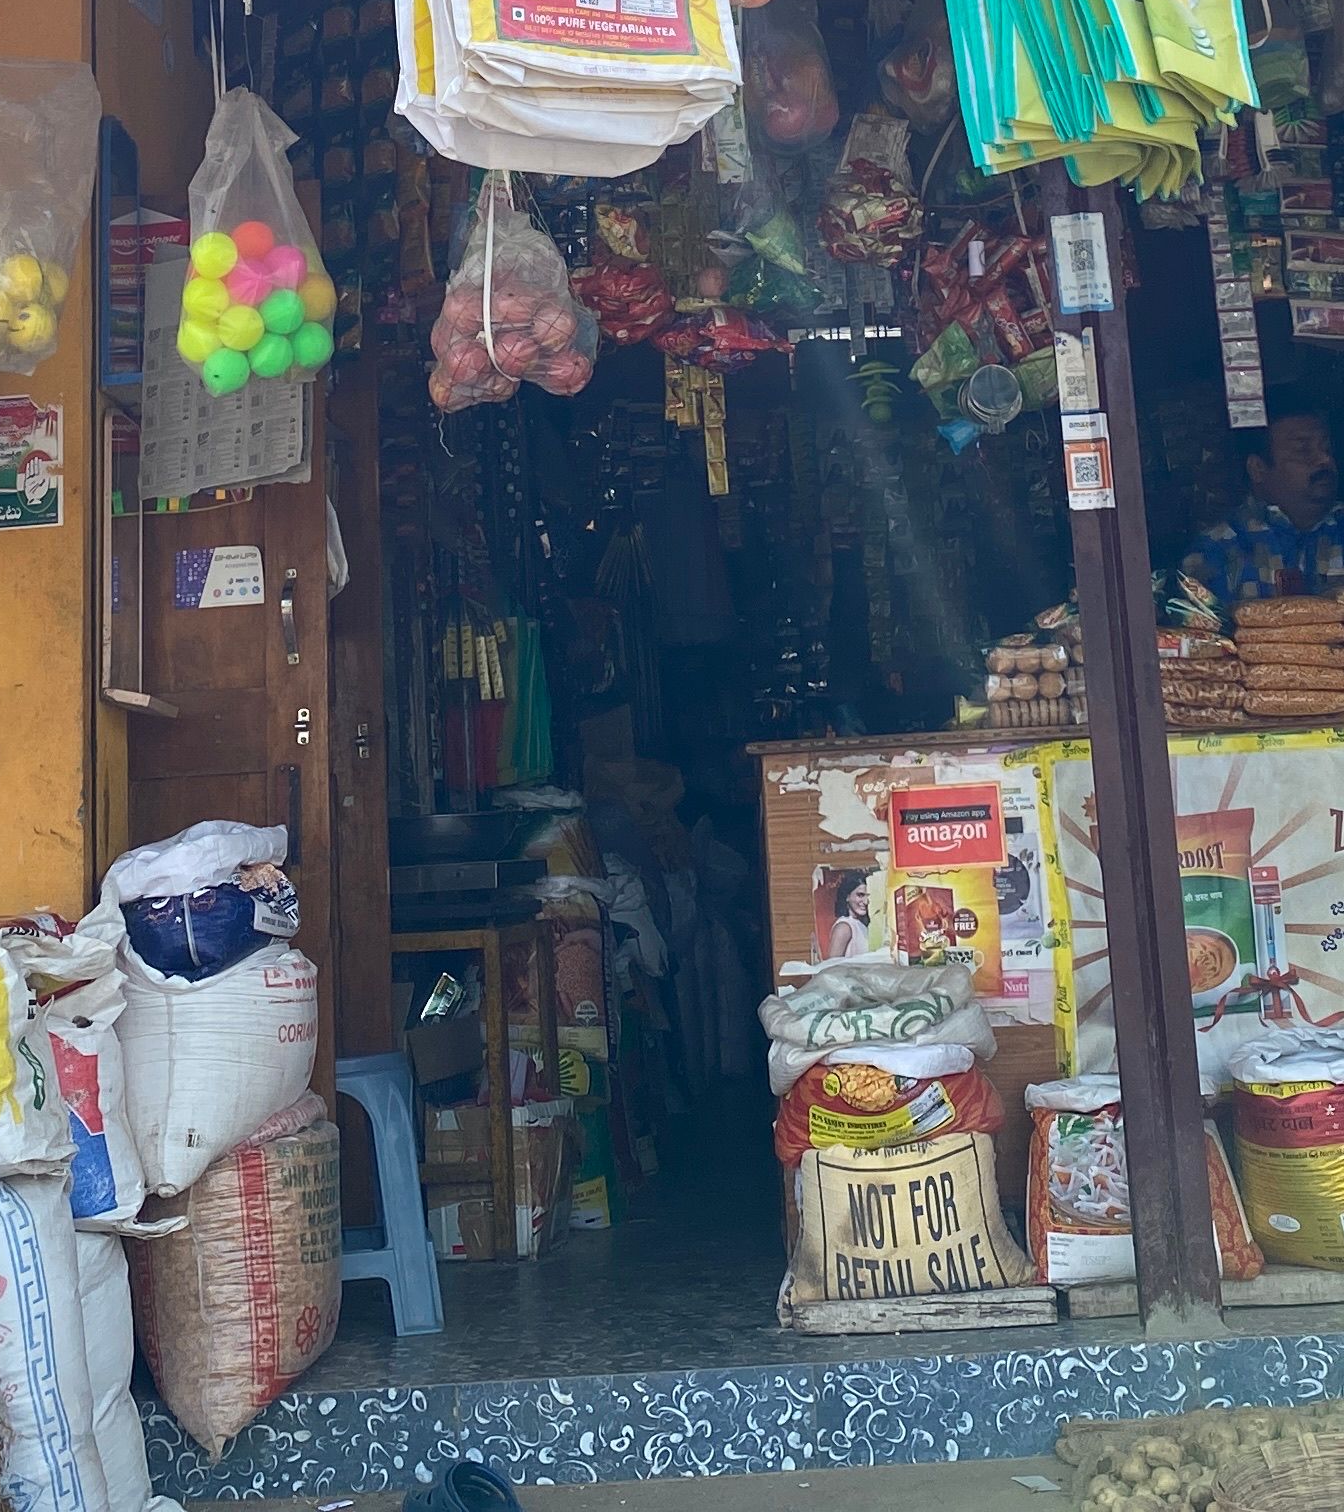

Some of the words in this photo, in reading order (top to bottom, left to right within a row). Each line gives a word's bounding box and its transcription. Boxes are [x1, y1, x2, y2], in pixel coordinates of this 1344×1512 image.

[529, 12, 556, 26] 100%
[557, 14, 586, 29] PURE
[587, 19, 654, 36] VEGETARIAN
[654, 26, 677, 37] TEA
[918, 809, 940, 822] using
[940, 807, 971, 820] Amazon
[971, 808, 987, 819] app
[907, 821, 988, 844] amazon
[953, 920, 978, 932] FREE
[847, 1182, 899, 1250] NOT
[908, 1170, 962, 1246] FOR
[835, 1251, 917, 1301] RETAIL
[927, 1233, 993, 1295] SALE
[256, 1296, 275, 1364] HOTEL
